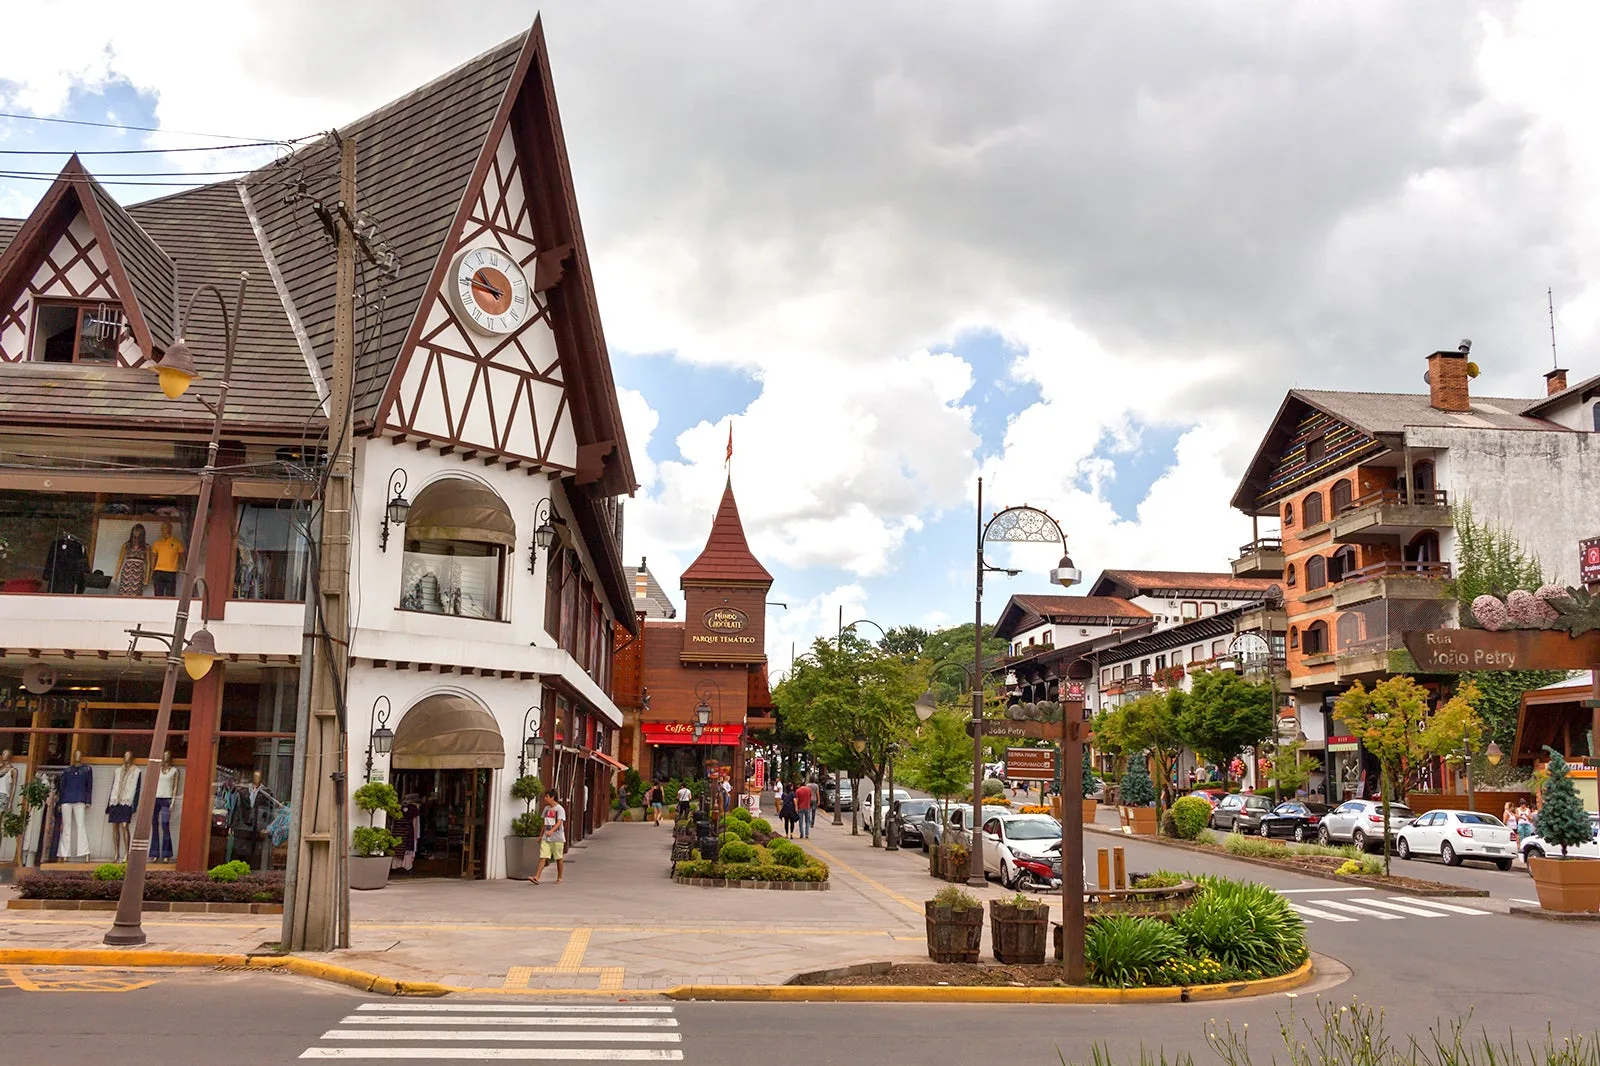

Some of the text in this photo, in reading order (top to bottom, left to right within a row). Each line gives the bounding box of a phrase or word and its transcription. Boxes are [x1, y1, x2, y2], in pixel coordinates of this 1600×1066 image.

[692, 635, 756, 644] PARQUE TEMÁTICO
[1426, 633, 1452, 644] Rua
[1428, 649, 1516, 669] João Petry
[664, 724, 686, 734] Coffe
[686, 725, 693, 733] &
[1008, 727, 1025, 736] Petry
